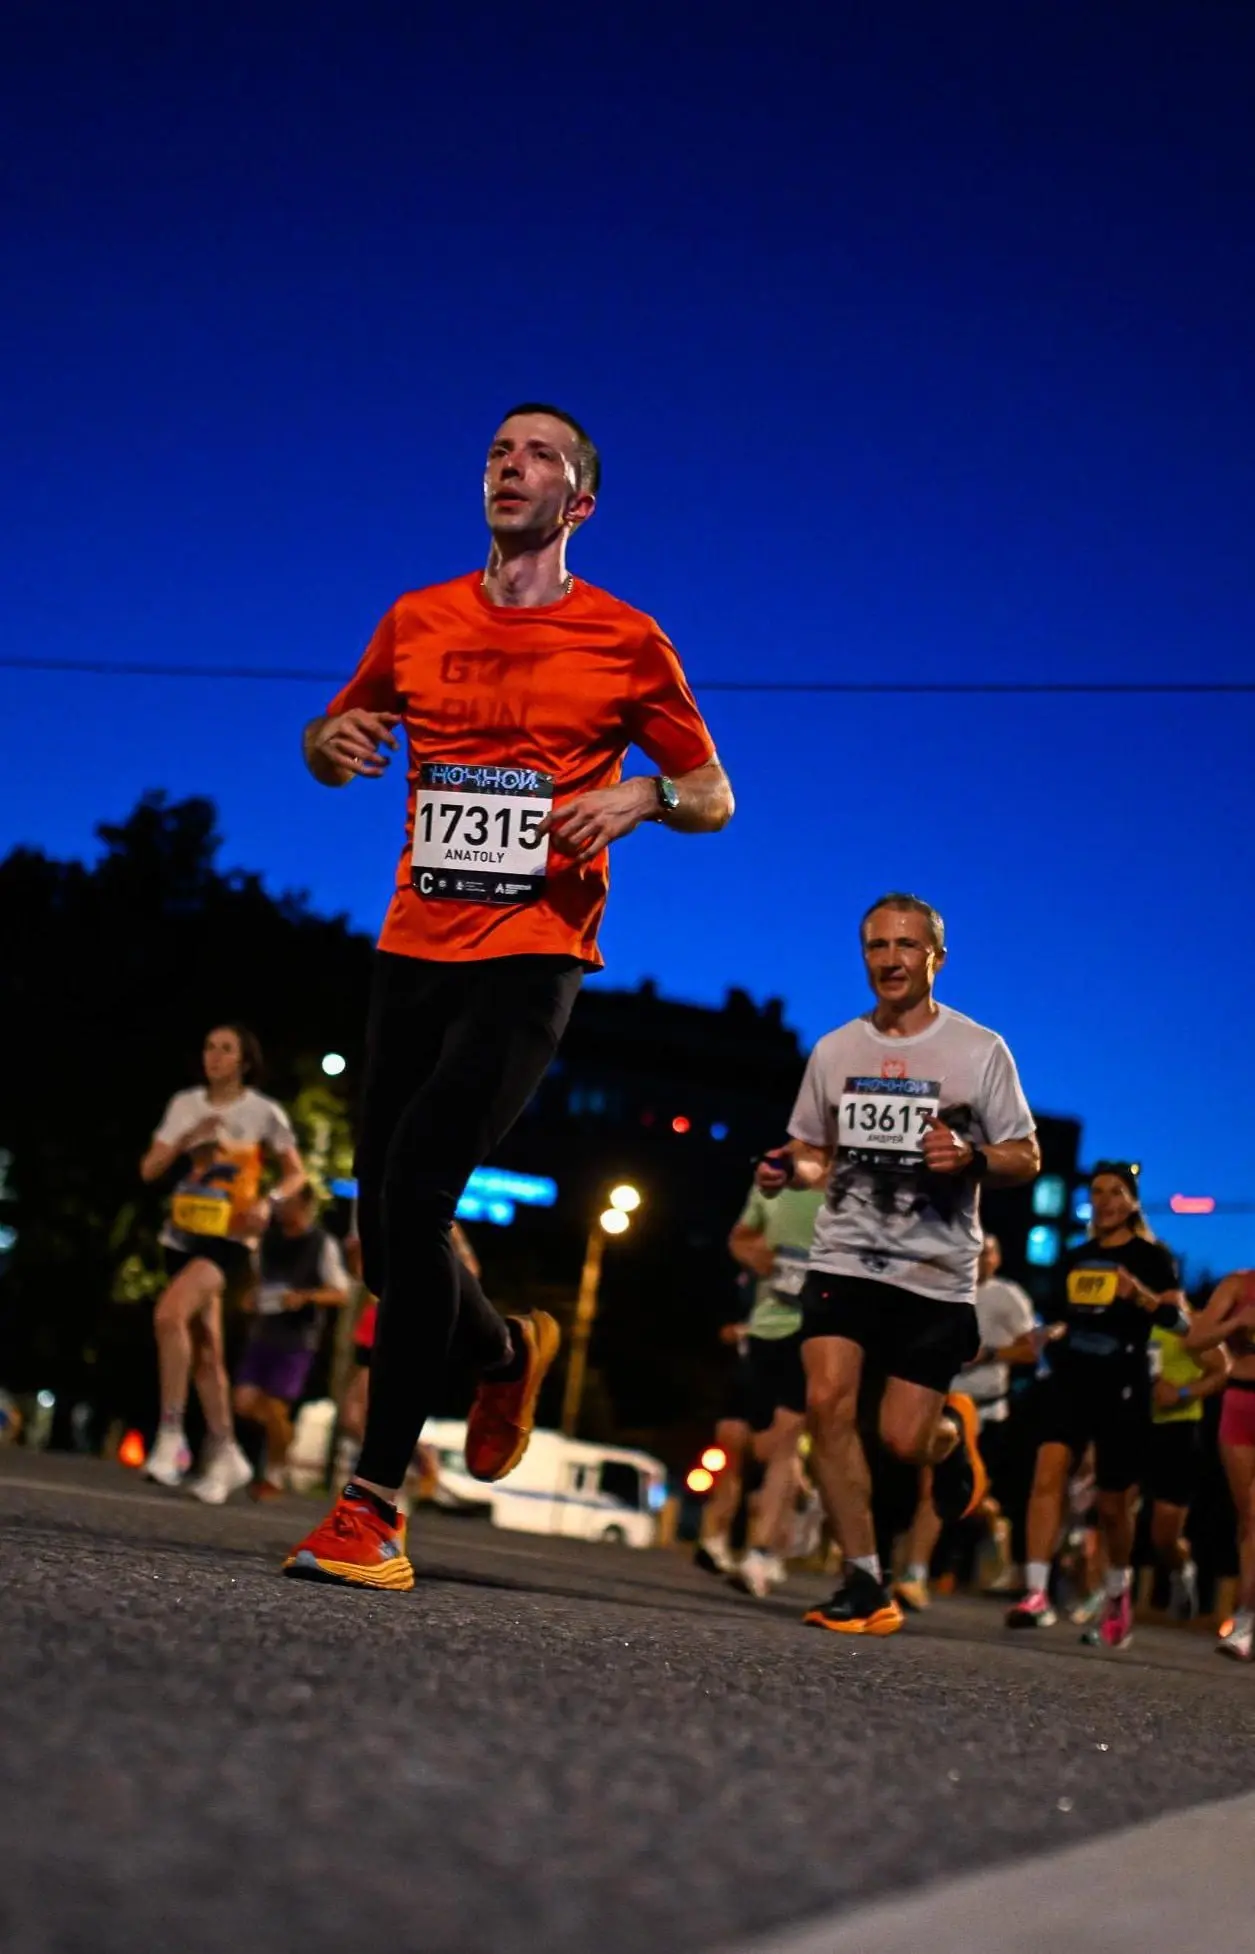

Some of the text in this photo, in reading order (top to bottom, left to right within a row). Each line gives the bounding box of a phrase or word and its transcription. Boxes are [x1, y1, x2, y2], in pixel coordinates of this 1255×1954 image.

[431, 766, 540, 791] НОЧНОЙ
[420, 802, 545, 850] 17315
[444, 848, 505, 864] ANATOLY
[845, 1102, 934, 1135] 13617
